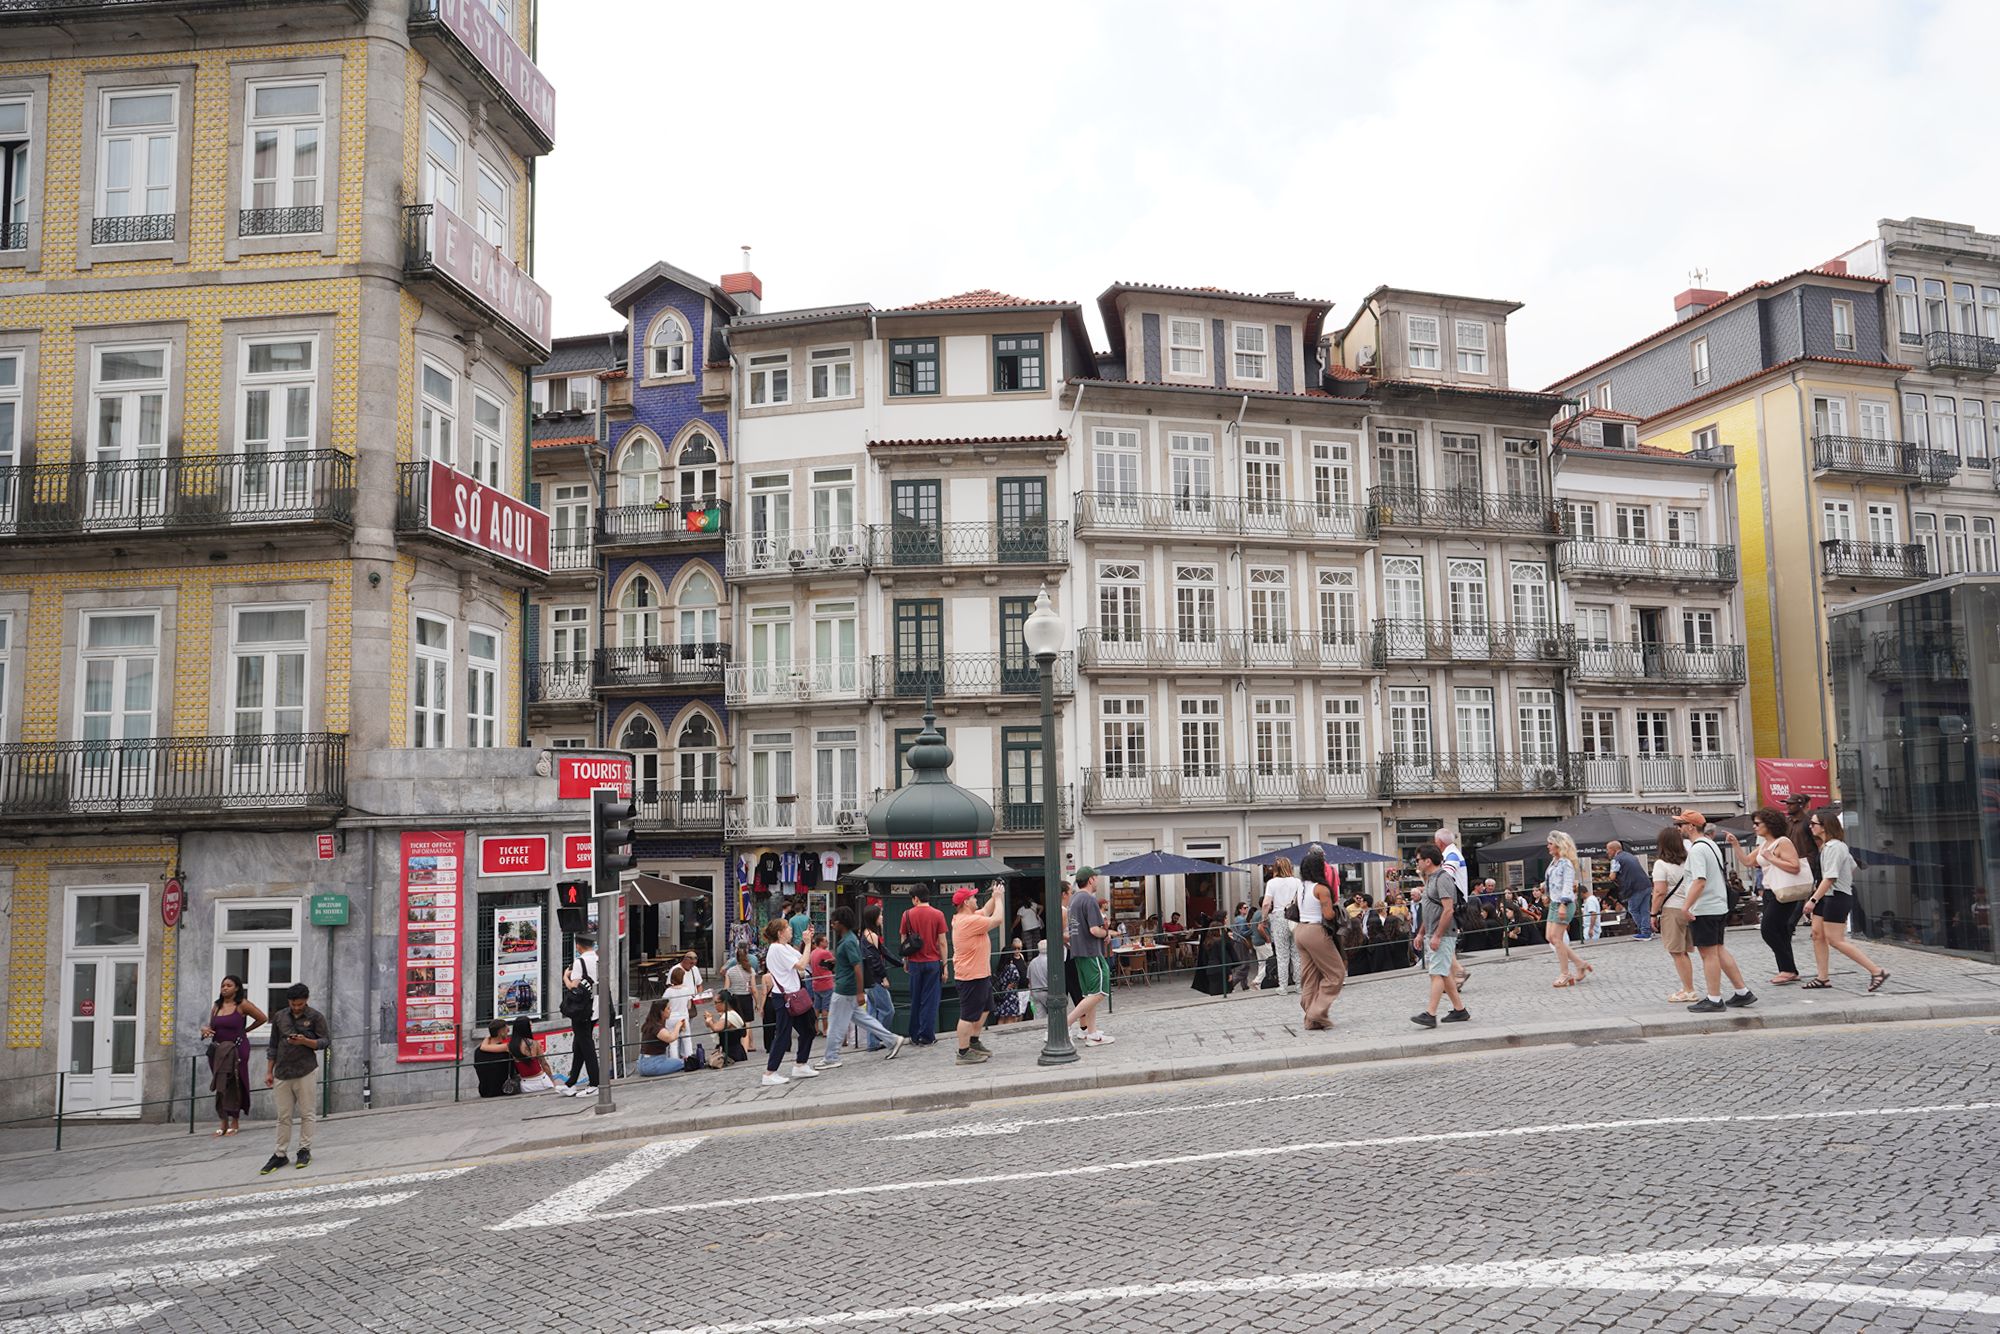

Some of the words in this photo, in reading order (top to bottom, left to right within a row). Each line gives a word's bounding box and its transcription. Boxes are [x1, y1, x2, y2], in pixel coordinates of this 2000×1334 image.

[520, 62, 552, 131] BEM
[446, 219, 457, 266] E
[472, 241, 544, 335] BARATO
[454, 483, 483, 534] SÓ
[490, 501, 532, 556] AQUI
[571, 763, 621, 780] TOURIST
[1655, 805, 1682, 816] Invicta
[499, 845, 529, 855] TICKET
[576, 843, 592, 851] TOUR
[941, 841, 968, 849] TOURIST
[576, 853, 592, 862] SERV
[942, 849, 968, 857] SERVICE
[499, 855, 529, 865] OFFICE
